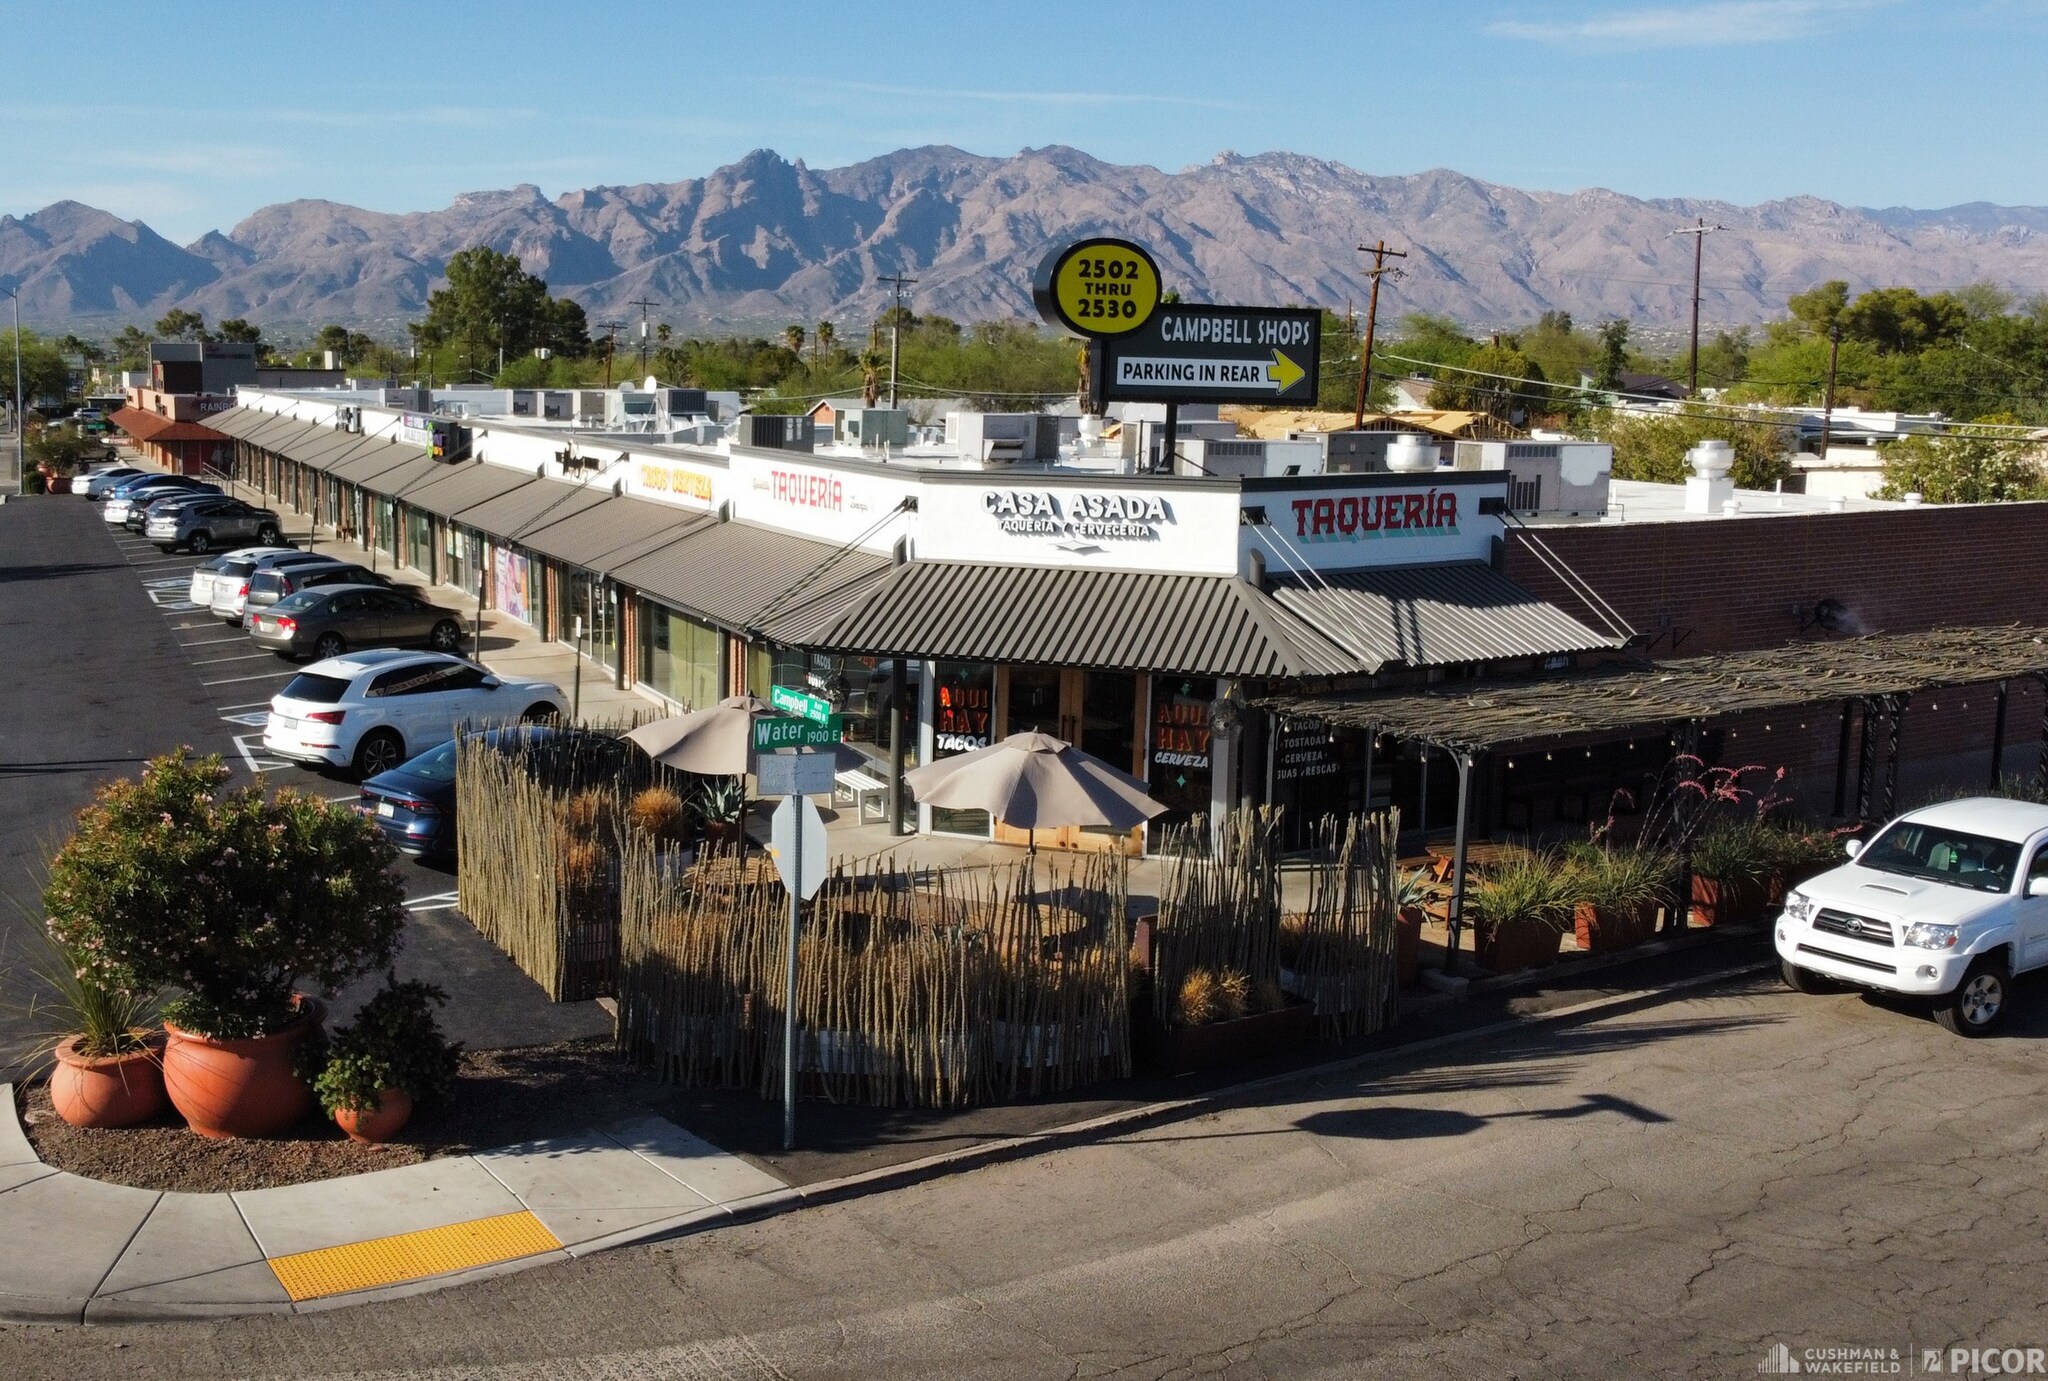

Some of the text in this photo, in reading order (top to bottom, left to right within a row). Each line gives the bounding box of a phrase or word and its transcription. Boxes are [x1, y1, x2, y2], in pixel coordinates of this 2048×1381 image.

[1079, 259, 1139, 279] 2502
[1085, 283, 1132, 296] THRU
[1078, 299, 1137, 318] 2530
[1161, 316, 1310, 346] CAMPBELL SHOPS
[1123, 363, 1260, 383] PARKING IN REAR
[771, 470, 842, 512] TAQUERÍA
[981, 490, 1167, 520] CASA ASADA
[1291, 488, 1458, 537] TAQUERÍA
[1061, 521, 1069, 533] Y
[774, 687, 808, 713] Campbell
[940, 709, 988, 734] HAY
[1293, 720, 1320, 731] TACOS
[757, 722, 804, 746] Water
[807, 730, 839, 744] 1900 E
[937, 733, 988, 752] TACOS
[1157, 728, 1211, 753] HAY
[1284, 735, 1326, 749] TOSTADAS
[1154, 751, 1208, 768] CERVEZA
[1285, 751, 1323, 764] CERVEZA
